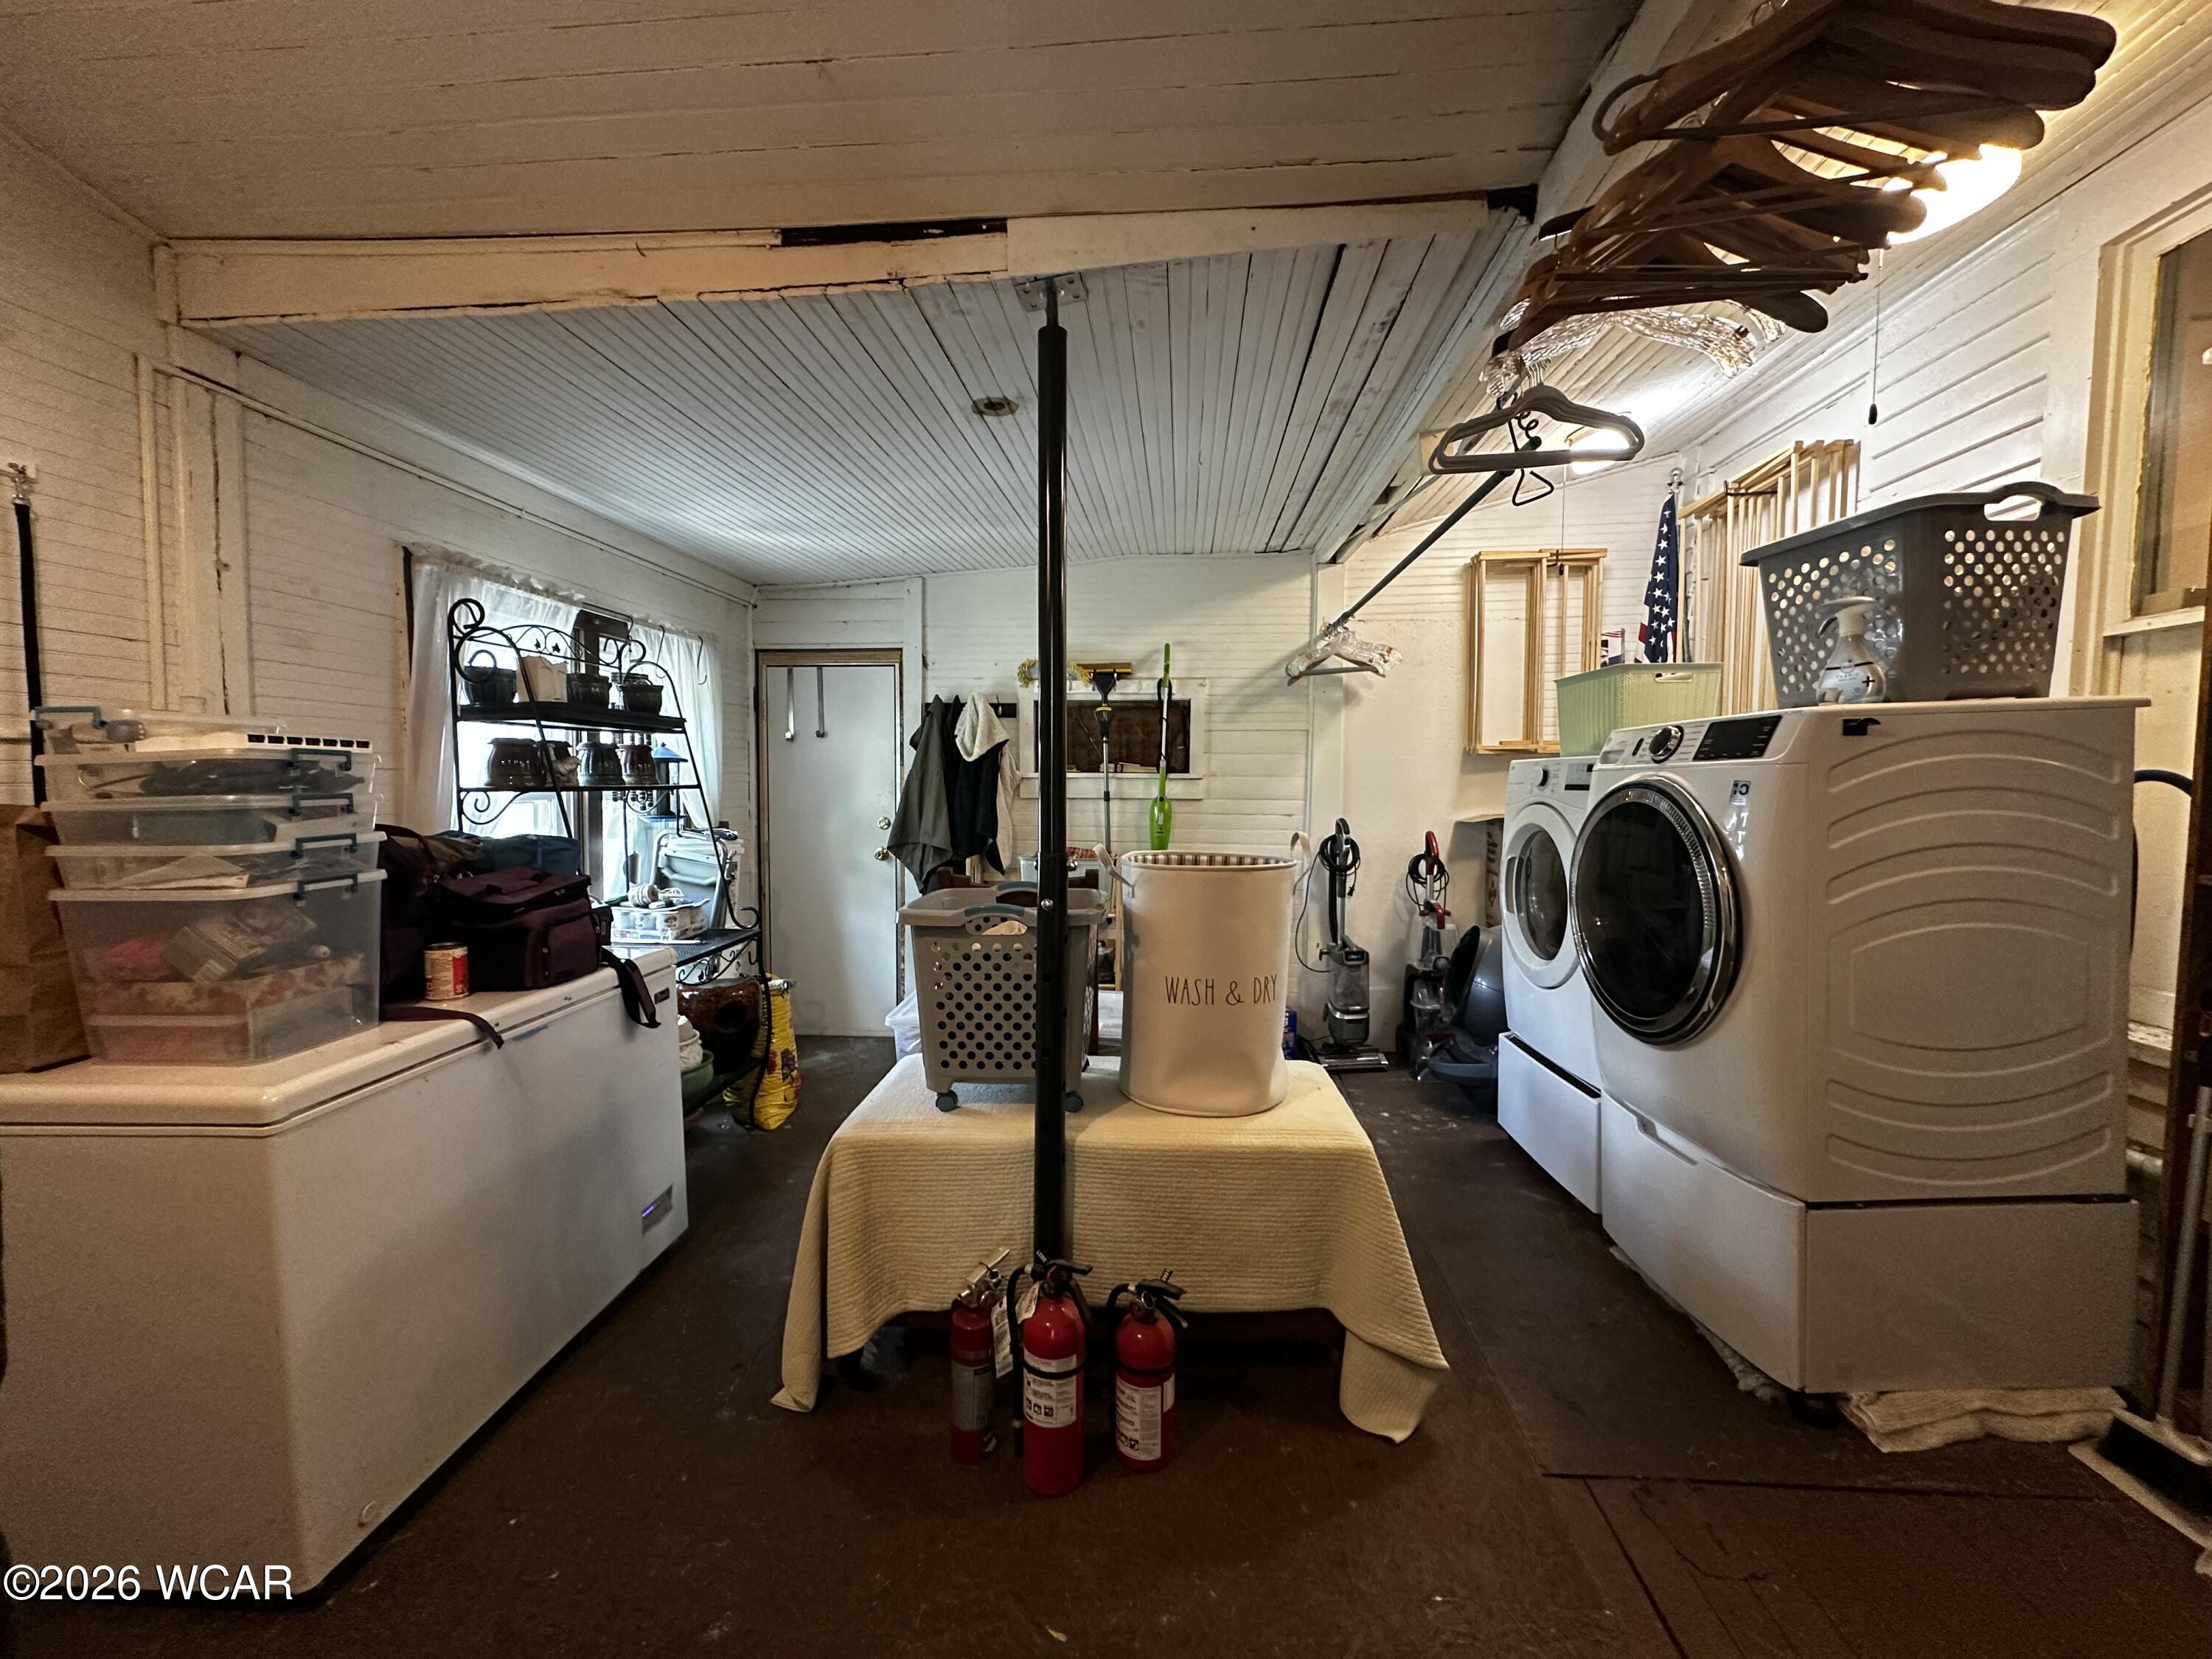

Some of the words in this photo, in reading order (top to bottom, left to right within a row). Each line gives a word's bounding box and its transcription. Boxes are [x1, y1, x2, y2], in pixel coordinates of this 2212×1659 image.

[1733, 782, 1750, 796] 10
[1165, 975, 1214, 1006] WASH
[1225, 980, 1245, 1006] &
